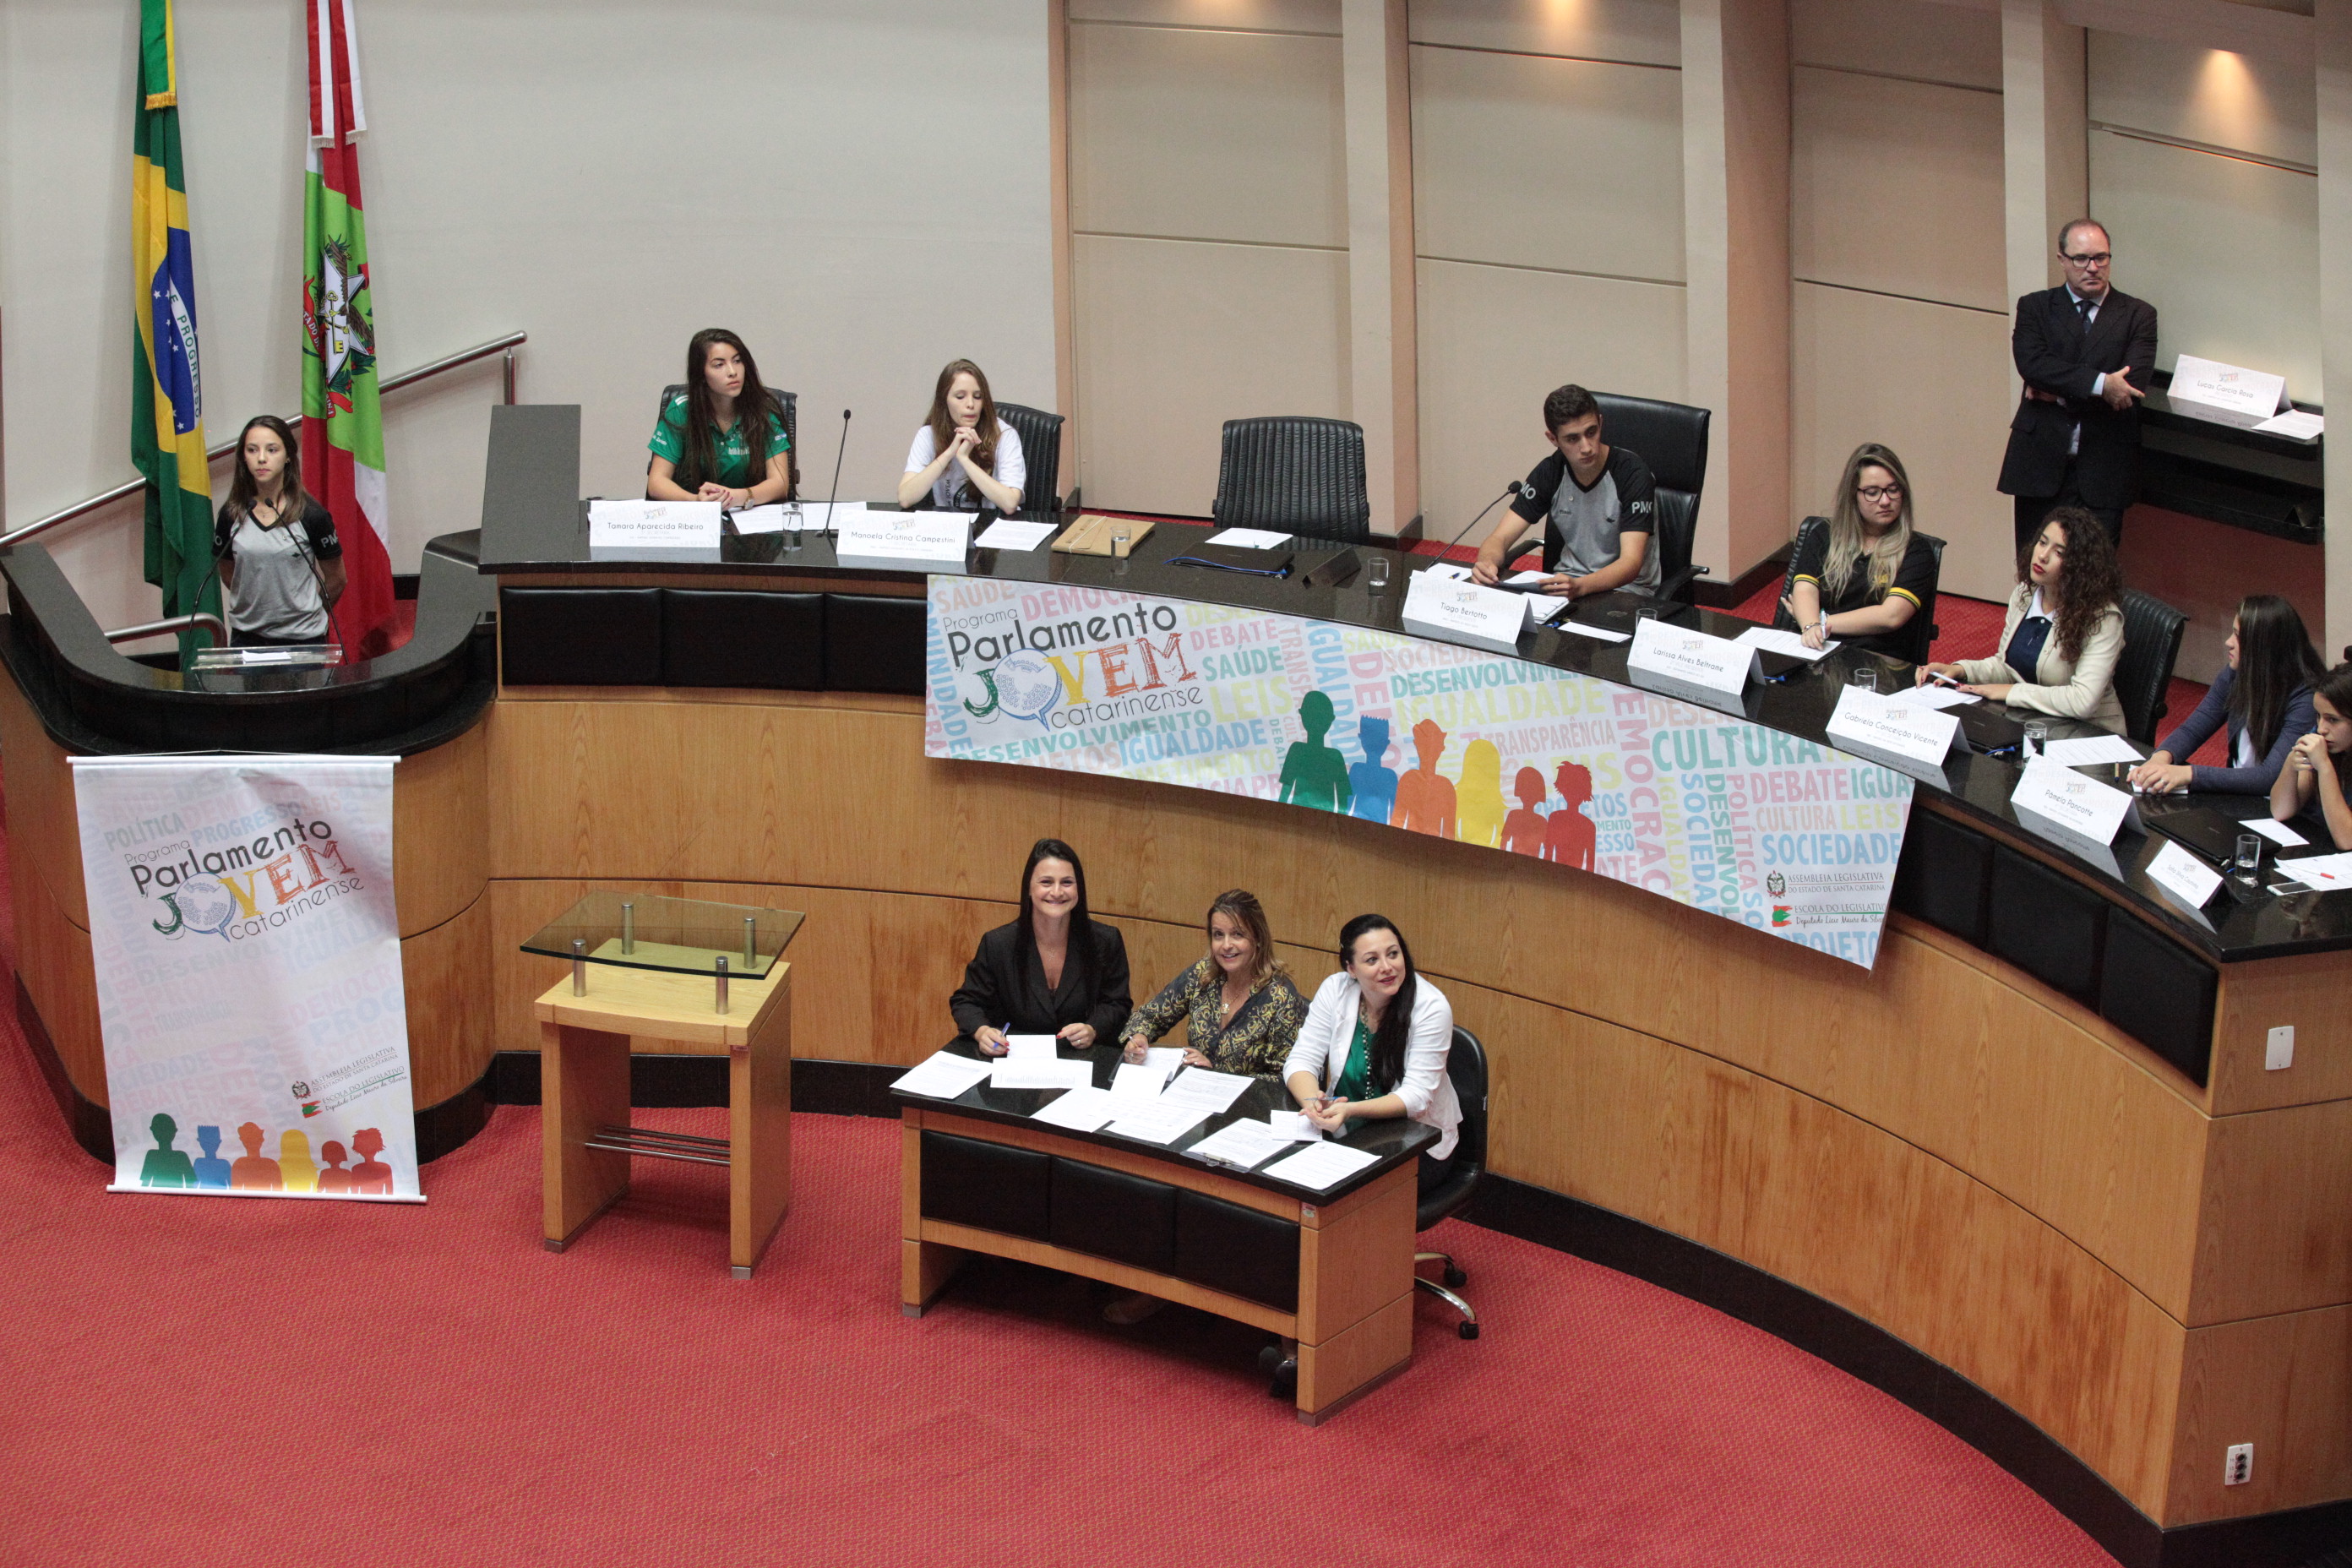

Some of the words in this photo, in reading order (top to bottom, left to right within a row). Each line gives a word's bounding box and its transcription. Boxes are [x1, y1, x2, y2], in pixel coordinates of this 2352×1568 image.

[2197, 379, 2214, 389] Lucas
[2216, 384, 2238, 395] Garcia
[2238, 389, 2254, 399] Rosa
[607, 522, 634, 531] Tamara
[635, 522, 677, 532] Aparecida
[678, 522, 704, 531] Ribeiro
[851, 531, 884, 541] Manoela
[885, 533, 913, 542] Cristina
[942, 607, 1019, 632] Programa
[1440, 602, 1460, 613] Tiago
[1460, 607, 1488, 620] Bertotto
[946, 602, 1178, 668] Parlamento
[1189, 618, 1279, 652] DEBATE
[1201, 644, 1286, 683] SAÚDE
[1652, 647, 1676, 660] Larissa
[1677, 653, 1695, 665] Alves
[1696, 657, 1724, 672] Beltrame
[962, 632, 1199, 728] JOVEM
[1050, 686, 1204, 729] catarinense
[1208, 674, 1293, 724] LEIS
[1395, 678, 1607, 733] IGUALDADE
[1117, 719, 1268, 766] IGUALDADE
[1843, 711, 1874, 727] Gabriela
[1875, 721, 1913, 738] Conceição
[1914, 732, 1938, 747] Vicente
[1651, 726, 1822, 772] CULTURA
[1749, 768, 1850, 804] DEBATE
[189, 801, 302, 847] PROGRESSO
[1756, 804, 1838, 833] CULTURA
[1839, 803, 1901, 830] LEIS
[2066, 799, 2094, 817] Pancotte
[102, 811, 188, 853] POLÍTICA
[1726, 775, 1759, 891] POLÍTICA
[1761, 832, 1902, 867] SOCIEDADE
[123, 839, 192, 866] Programa
[129, 818, 333, 896] Parlamento
[151, 840, 357, 940] JOVEM
[1788, 874, 1832, 884] ASSEMBLEIA
[1833, 872, 1885, 882] LEGISLATIVA
[1854, 884, 1886, 892] CATARINA
[229, 876, 365, 940] catarinense
[1794, 904, 1825, 914] ESCOLA
[1826, 904, 1840, 912] DO
[311, 1064, 351, 1086] ASSEMBLEIA
[351, 1046, 395, 1066] LEGISLATIVA
[323, 1077, 345, 1089] ESTADO
[352, 1065, 371, 1076] SANTA
[370, 1054, 399, 1069] CATARINA
[322, 1089, 349, 1105] ESCOLA
[348, 1083, 361, 1093] DO
[361, 1064, 406, 1086] LEGISLATIVO
